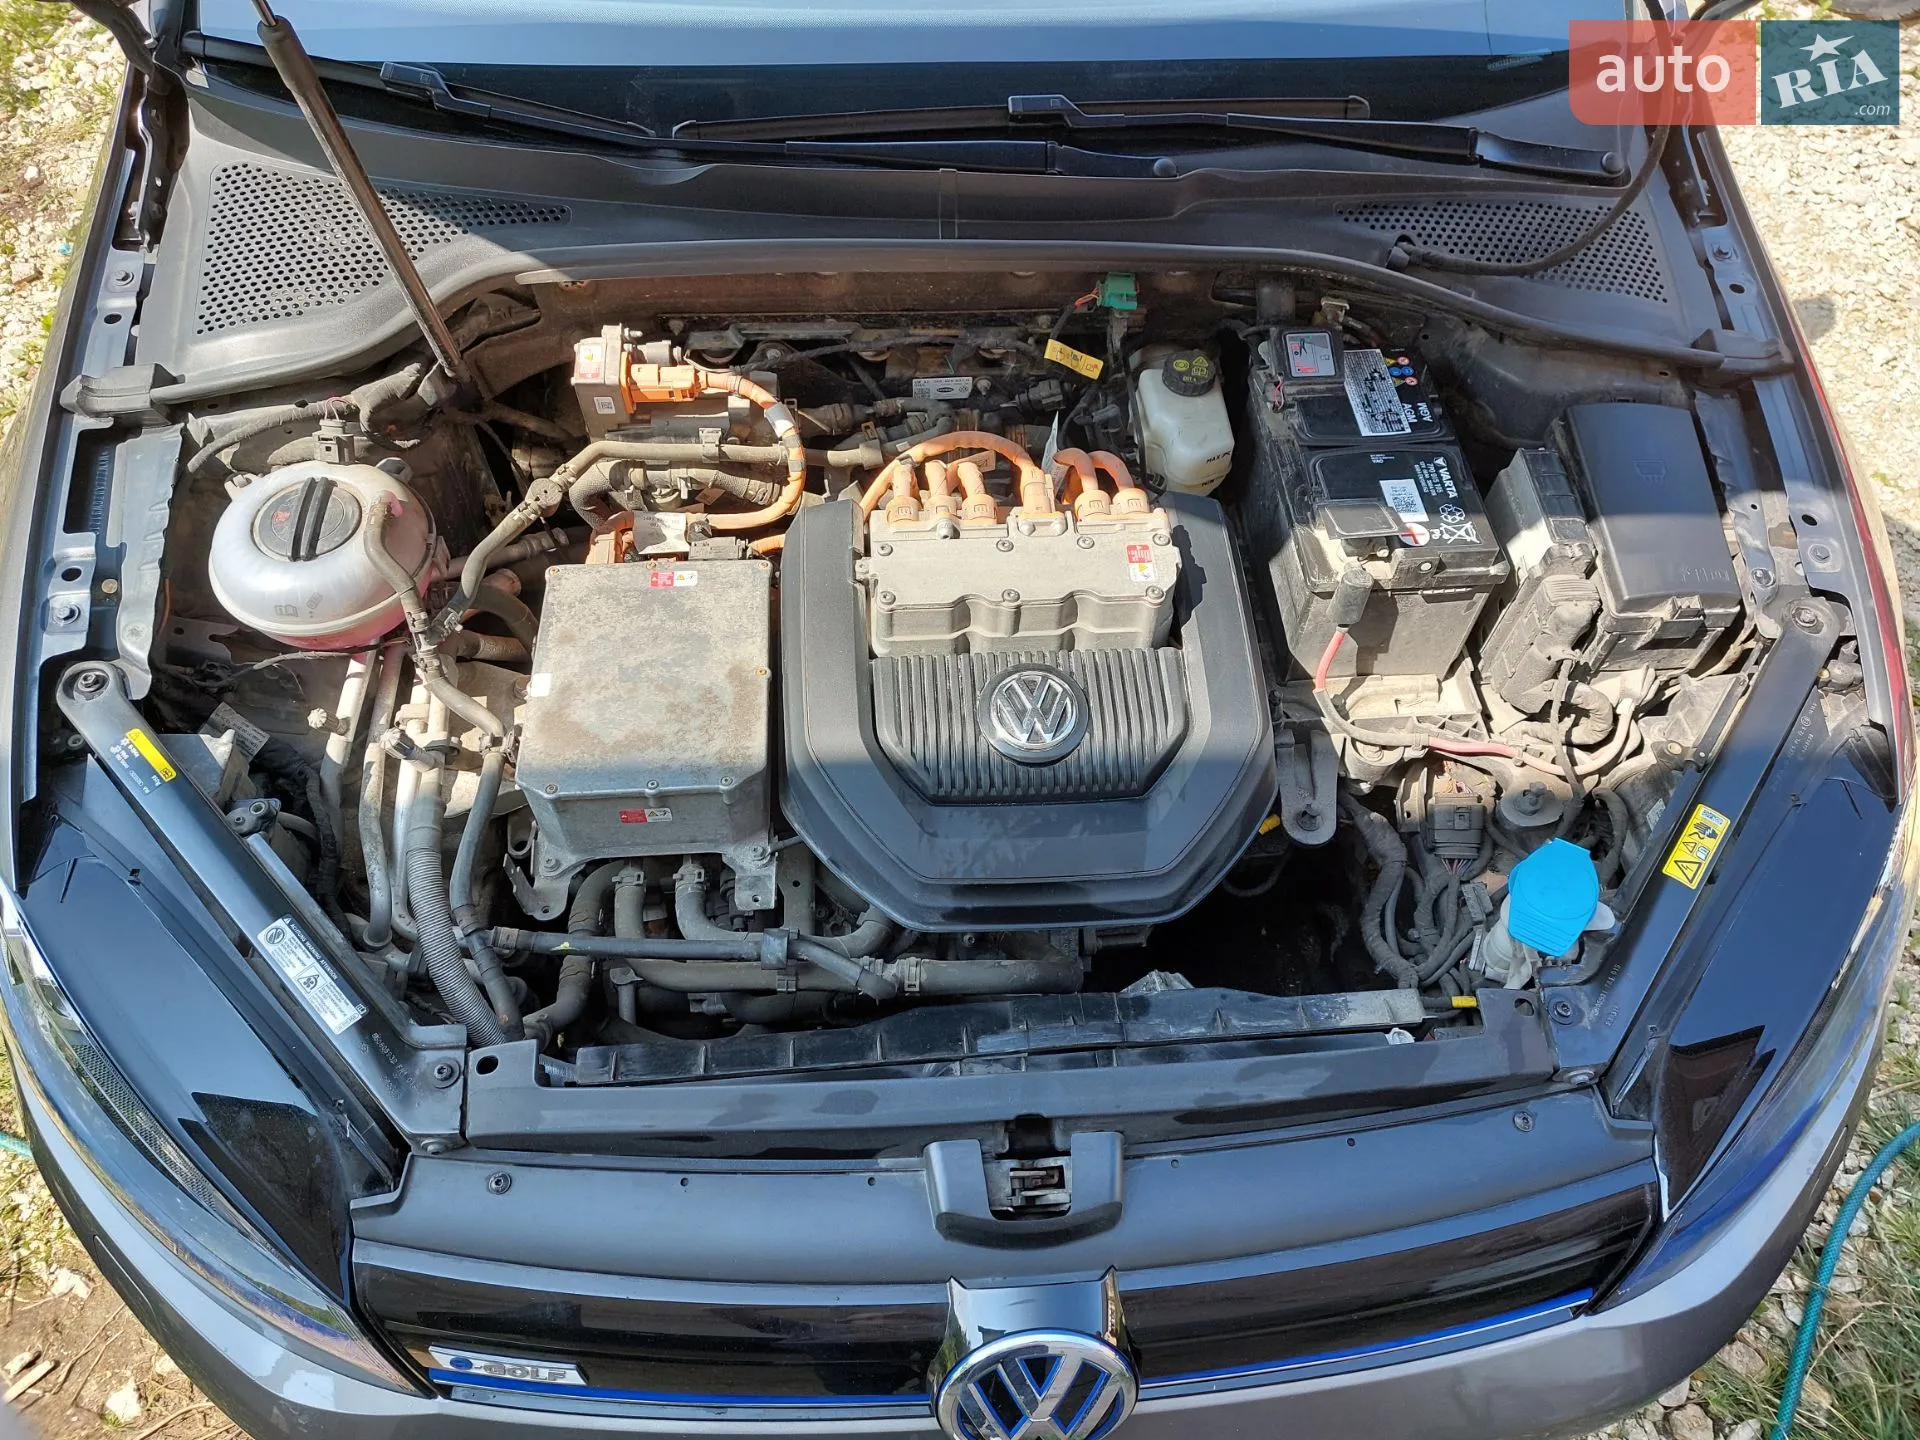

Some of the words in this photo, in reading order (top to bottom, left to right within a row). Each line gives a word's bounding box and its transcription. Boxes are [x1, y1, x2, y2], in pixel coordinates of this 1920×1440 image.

[1402, 403, 1418, 422] AGM
[1417, 402, 1433, 422] AGM
[1439, 467, 1458, 498] VARTA
[1430, 529, 1440, 539] Pb
[290, 923, 306, 942] ACHTUNG
[305, 940, 321, 960] WARNING
[319, 959, 338, 980] ATTENTION
